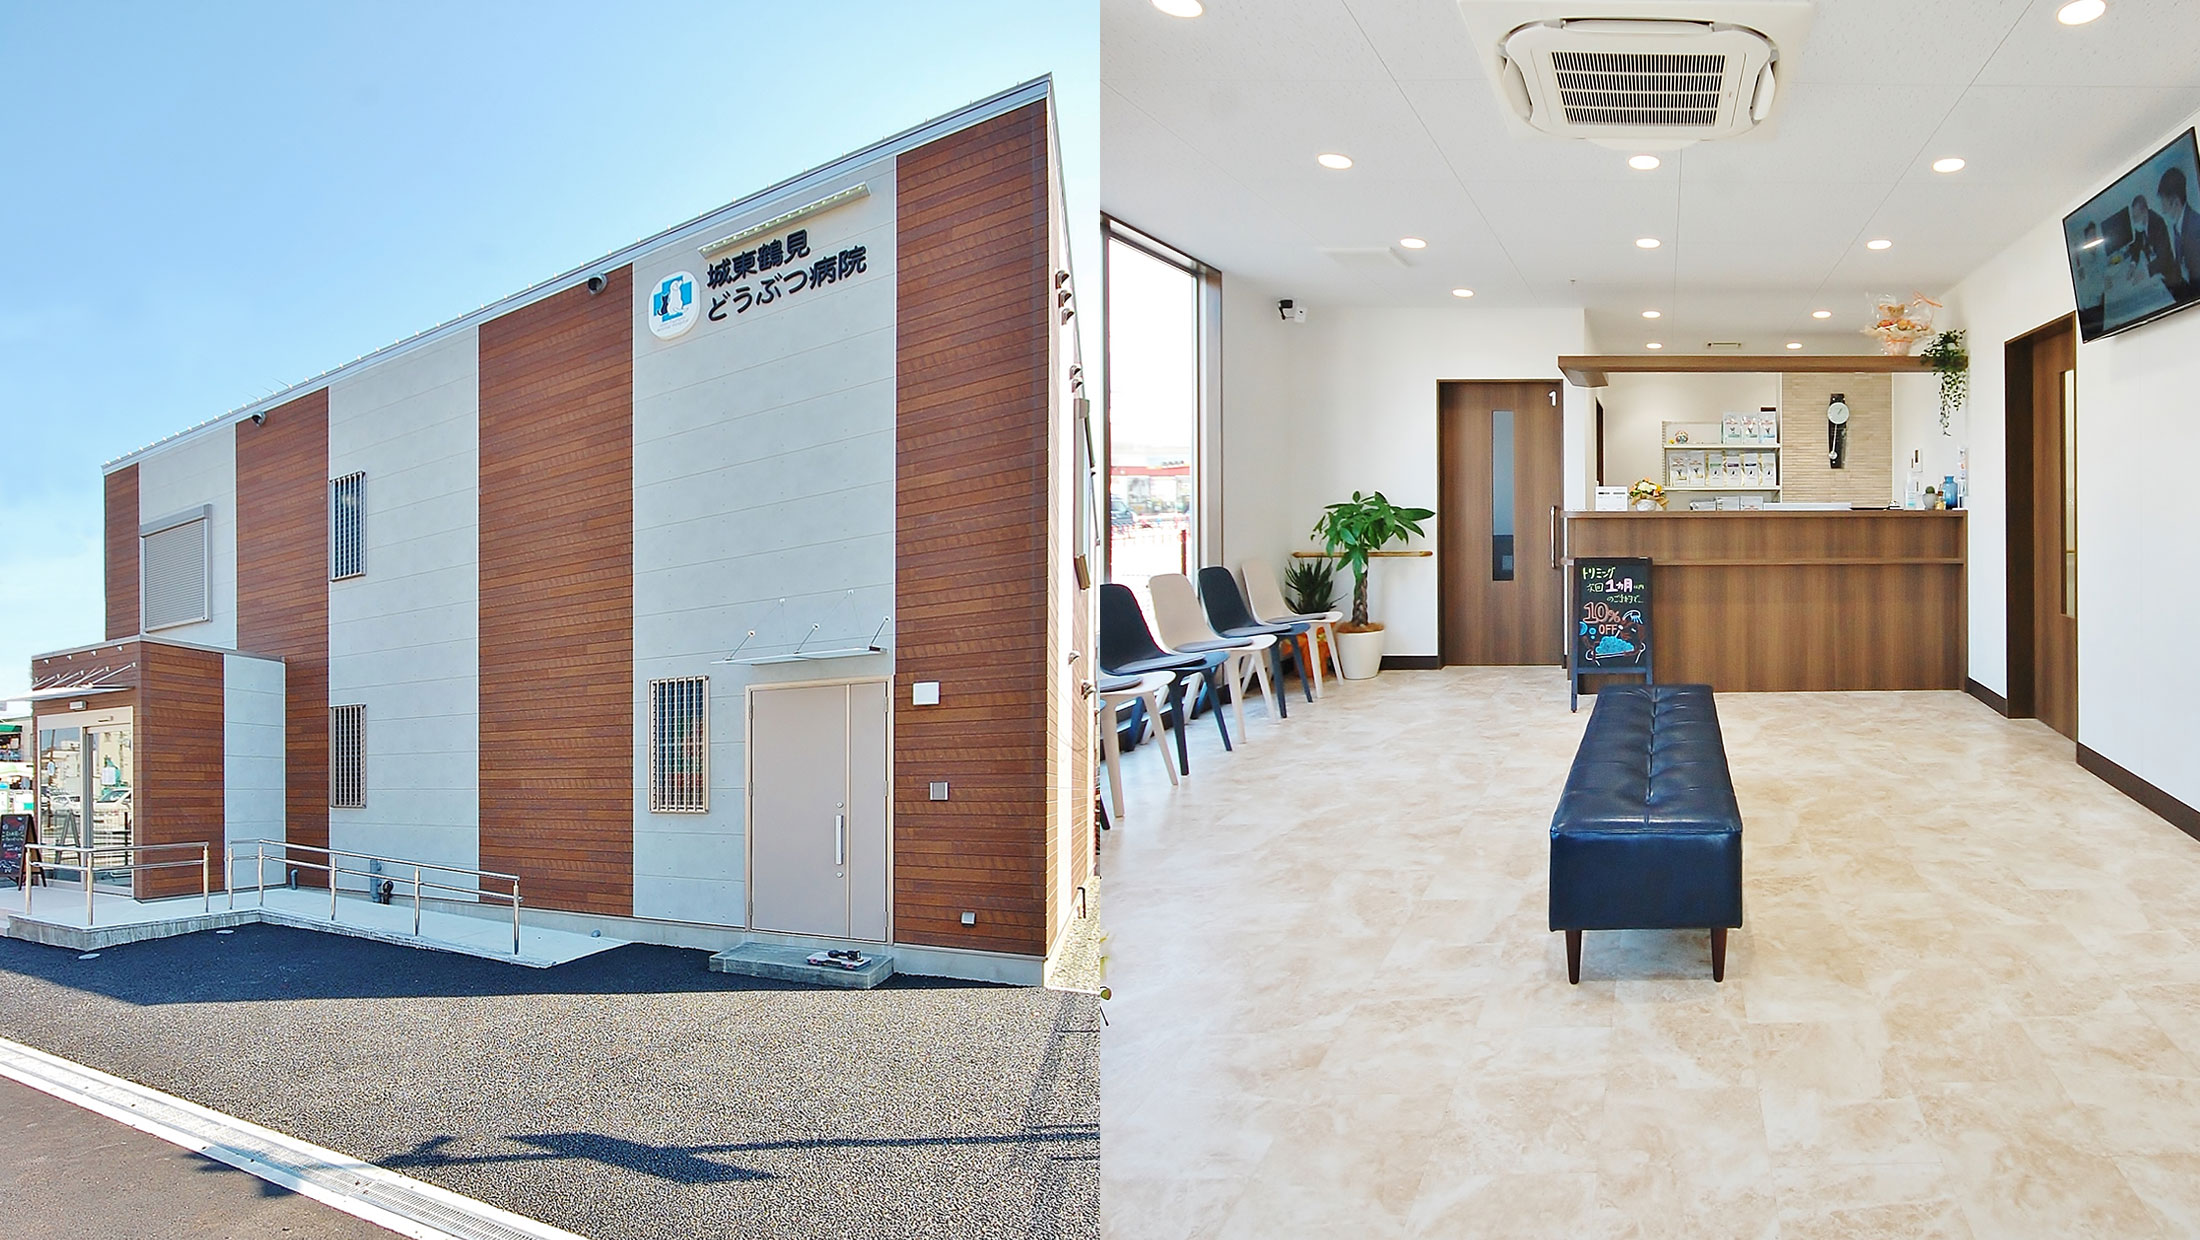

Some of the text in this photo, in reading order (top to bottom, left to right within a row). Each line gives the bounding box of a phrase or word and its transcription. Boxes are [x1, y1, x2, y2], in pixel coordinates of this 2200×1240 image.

[706, 229, 810, 289] 城東鶴見
[707, 245, 868, 322] どうぶつ病院
[1548, 390, 1557, 407] 1
[1583, 567, 1616, 579] トリミング
[1583, 602, 1620, 623] 10%
[1599, 624, 1618, 634] OFF
